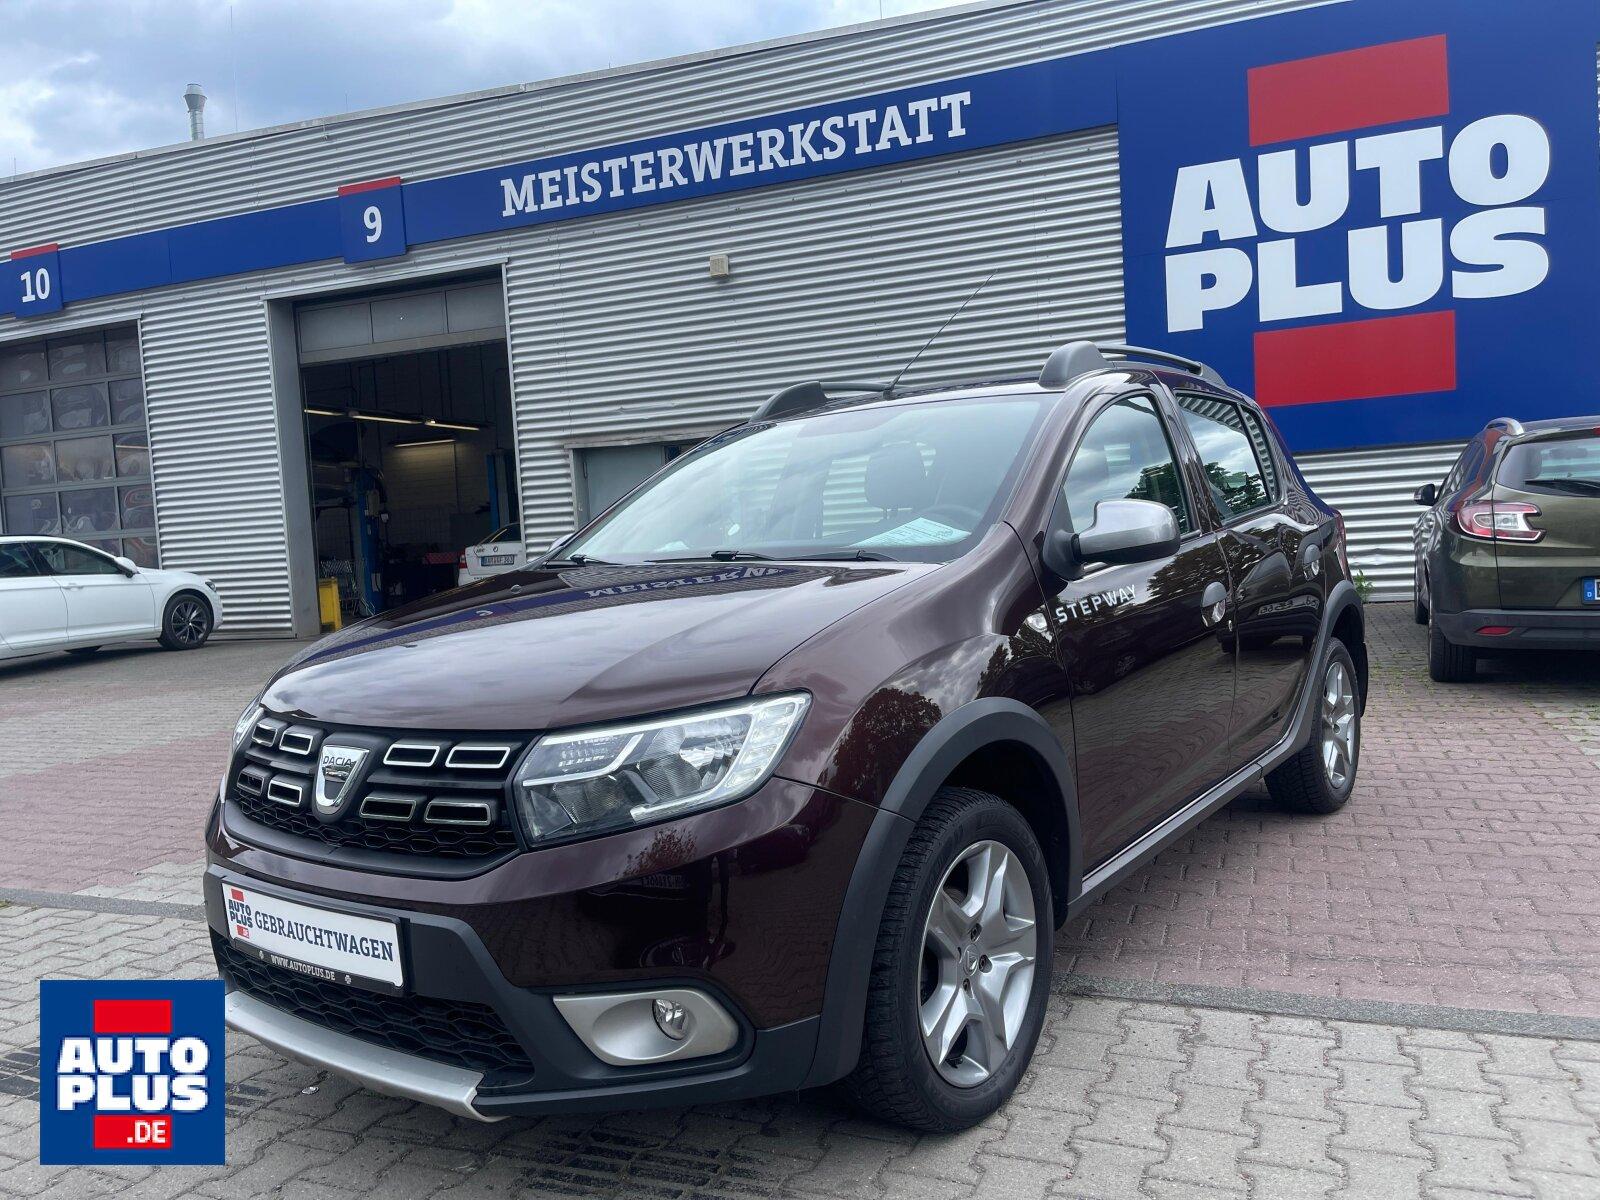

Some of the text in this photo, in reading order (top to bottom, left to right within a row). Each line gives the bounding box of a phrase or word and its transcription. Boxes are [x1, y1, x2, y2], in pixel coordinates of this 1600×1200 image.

[500, 91, 971, 217] MEISTERWERKSTATT
[1165, 114, 1550, 249] AUTO
[363, 205, 382, 243] 9
[19, 267, 51, 303] 10
[1165, 206, 1549, 333] PLUS
[1055, 584, 1136, 623] STEPWAY
[322, 755, 353, 768] DACIA
[228, 898, 252, 917] AUTO
[229, 910, 254, 929] PLUS
[254, 910, 394, 962] GEBRAUCHTWAGEN
[270, 954, 336, 981] WWW.AUTOPLUS.DE
